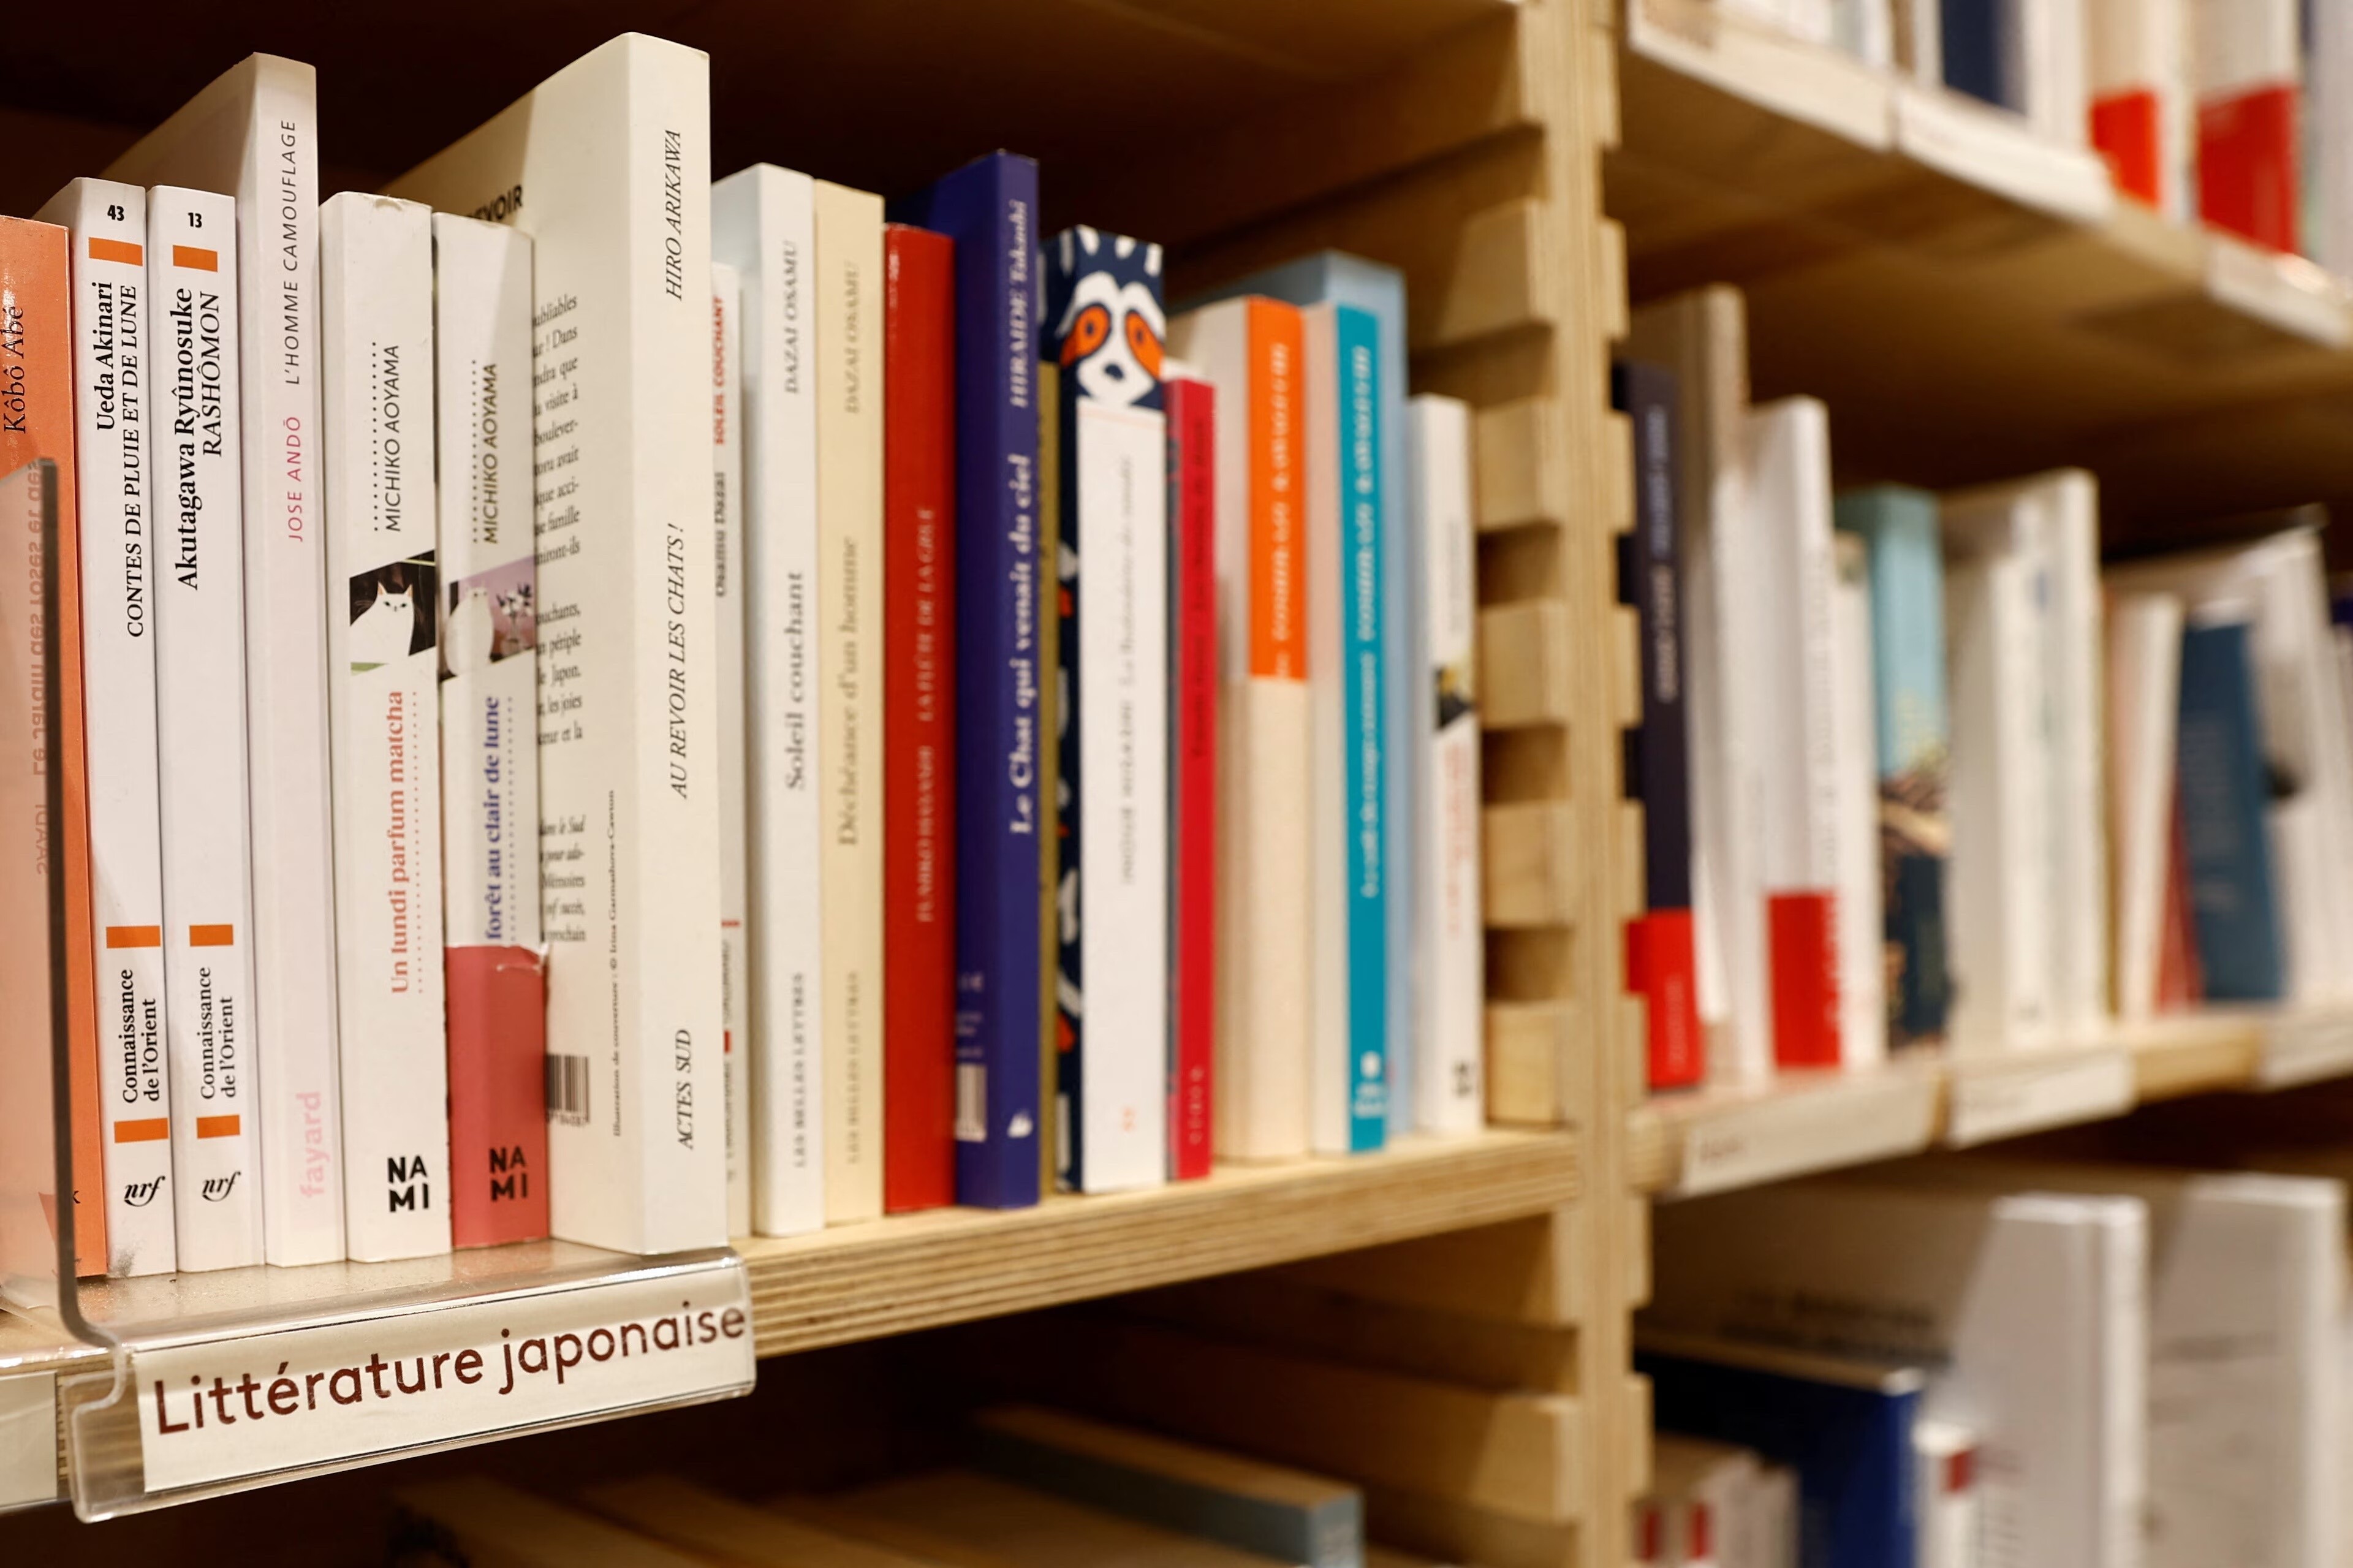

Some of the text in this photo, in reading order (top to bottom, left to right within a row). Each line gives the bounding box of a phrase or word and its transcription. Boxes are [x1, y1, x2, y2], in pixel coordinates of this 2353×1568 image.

[107, 205, 124, 221] 43
[188, 213, 202, 228] 13
[281, 121, 297, 271] CAMOUFLAGE
[466, 184, 523, 221] VOIR
[665, 129, 681, 301] HIRO ARIKAWA
[1, 306, 25, 433] Kôbô Abé
[92, 282, 115, 430] Ueda Akinari
[199, 292, 222, 456] RASHÔMON
[284, 282, 299, 384] L'HOMME
[783, 240, 800, 393] DAZAI OSAMU
[1010, 287, 1029, 408] HIRAIDE
[121, 286, 143, 637] CONTES DE PLUIE ET DE LUNE
[170, 289, 203, 590] Akutagawa Ryûnosuke
[384, 346, 400, 531] MICHIKO AOYAMA
[482, 364, 498, 543] MICHIKO AOYAMA
[287, 492, 303, 542] JOSE
[667, 535, 684, 615] CHATS
[668, 621, 685, 664] LES
[784, 573, 803, 789] Soleil couchant
[1009, 454, 1036, 833] Le Chat qui venait du ciel
[669, 668, 687, 759] REVOIR
[483, 697, 502, 939] forêt au clair de lune
[670, 761, 688, 799] AU
[386, 691, 409, 994] Un lundi parfum matcha
[118, 969, 136, 1103] Connaissance
[141, 999, 159, 1102] de l'Orient
[197, 967, 214, 1100] Connaissance
[218, 997, 236, 1098] de l'Orient
[676, 1029, 693, 1149] ACTES SUD
[124, 1176, 165, 1206] nrf
[202, 1172, 241, 1201] nrf
[300, 1091, 329, 1198] fayard
[388, 1156, 427, 1183] NA
[389, 1183, 428, 1213] MI
[154, 1301, 746, 1434] Littérature japonaise
